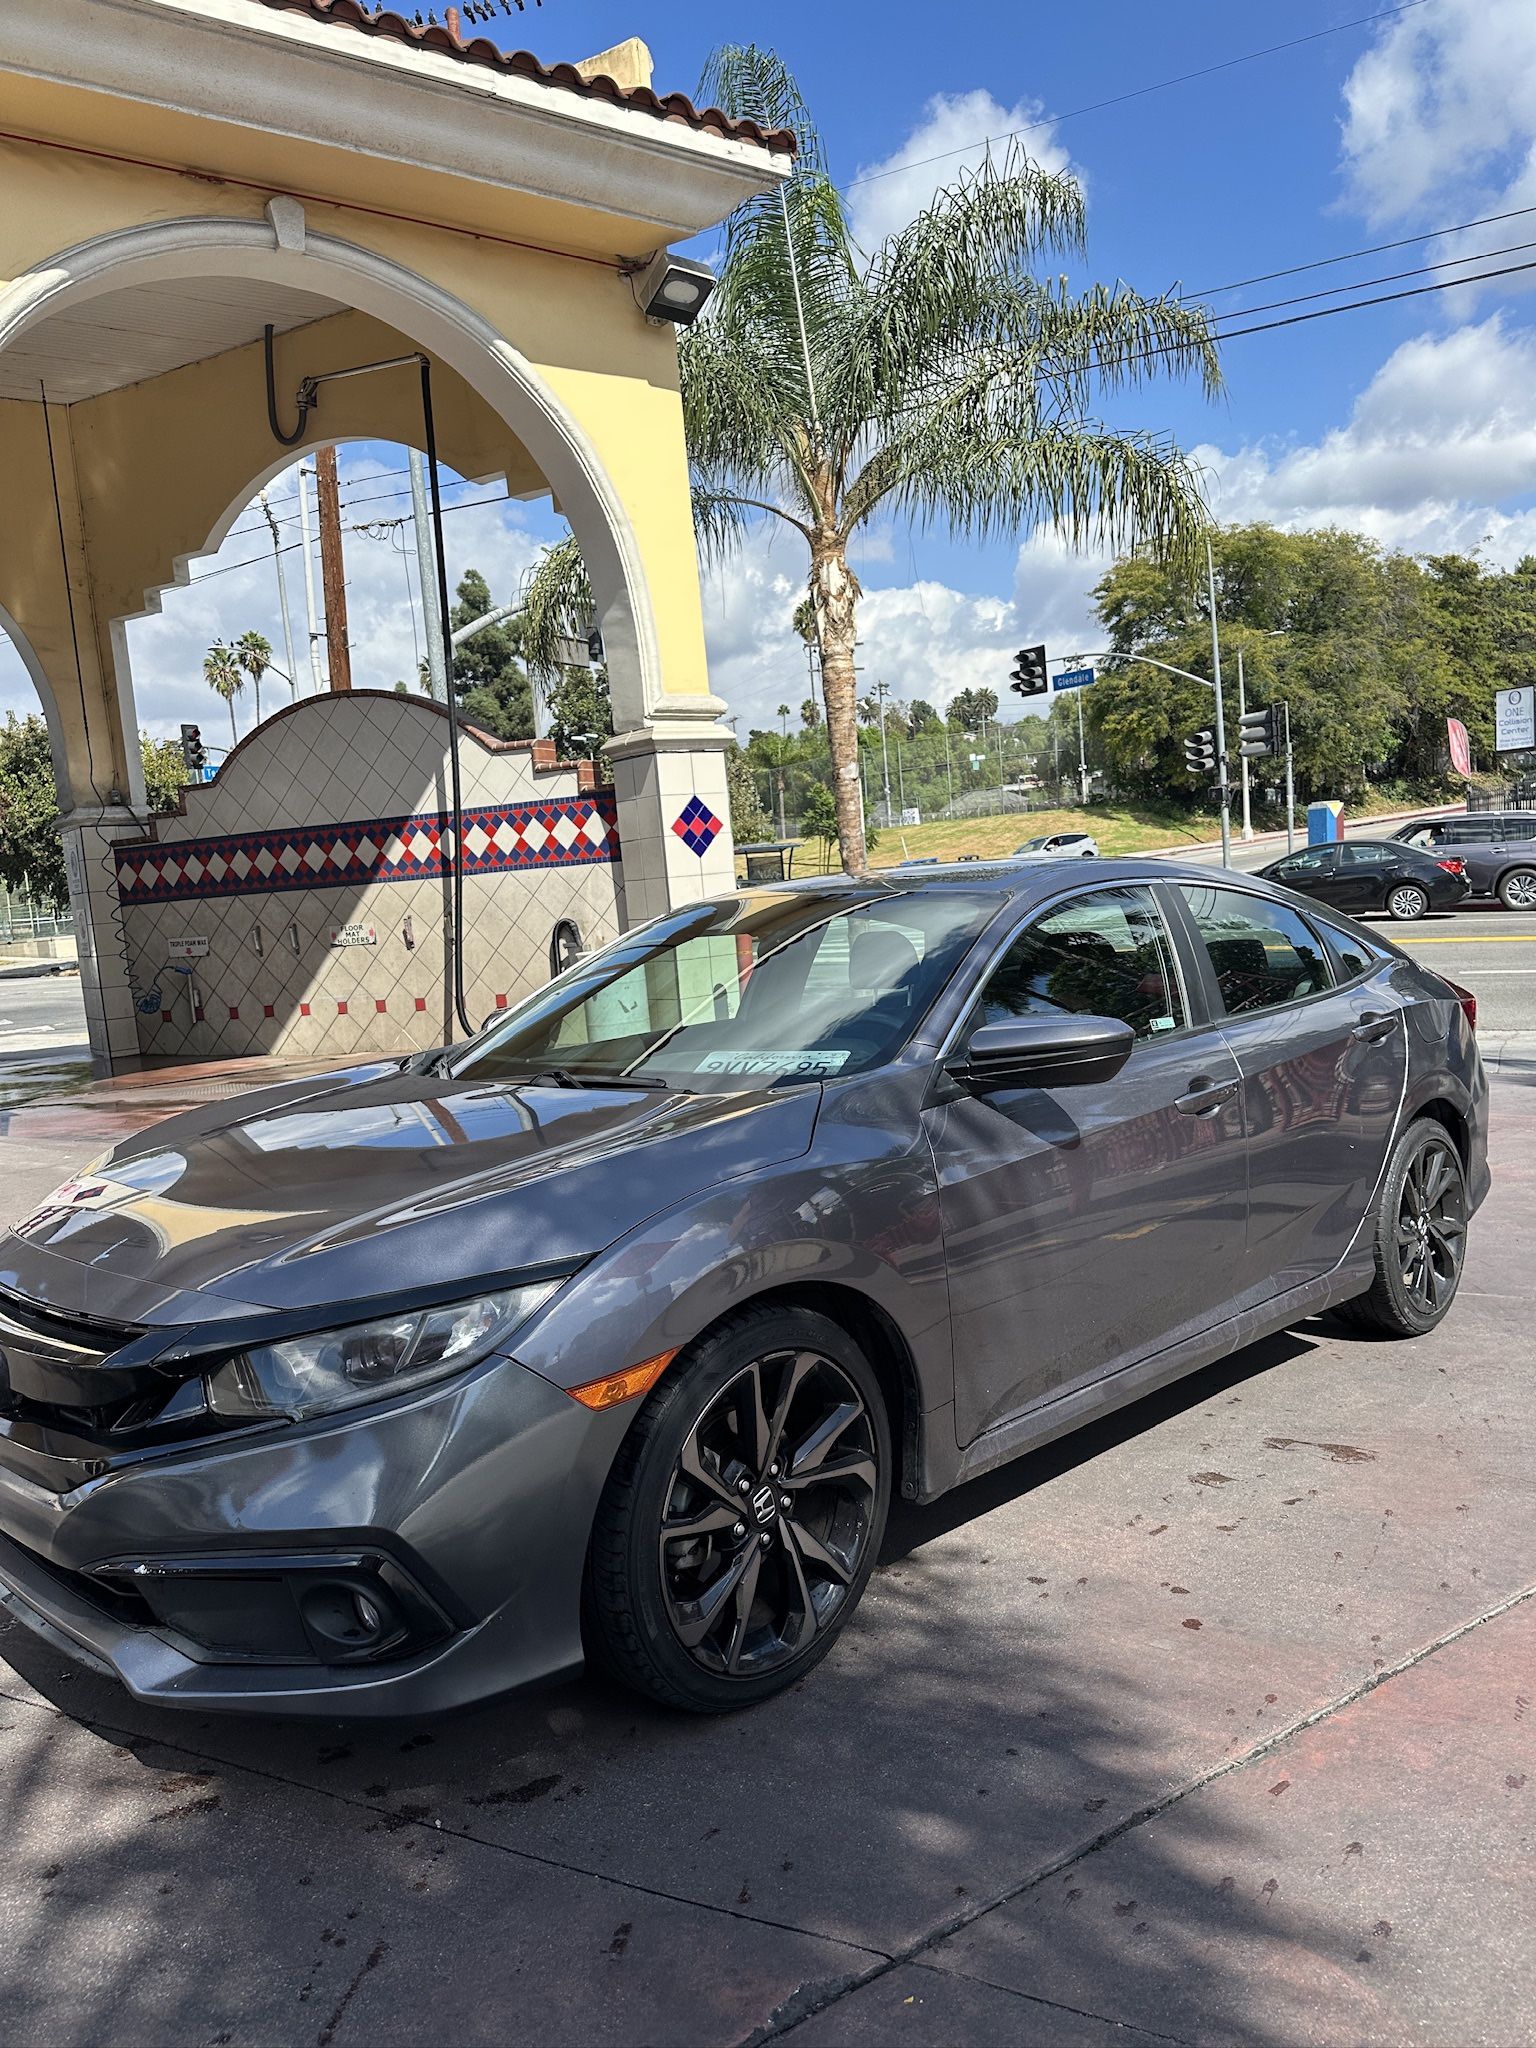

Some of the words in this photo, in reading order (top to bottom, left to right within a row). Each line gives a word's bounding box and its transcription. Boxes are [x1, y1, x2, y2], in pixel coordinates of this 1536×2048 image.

[1057, 673, 1089, 686] Glendale
[1505, 706, 1525, 717] ONE
[1499, 717, 1533, 727] Collision
[1501, 726, 1530, 735] Center
[340, 924, 364, 932] FLOOR
[337, 936, 370, 944] HOLDERS
